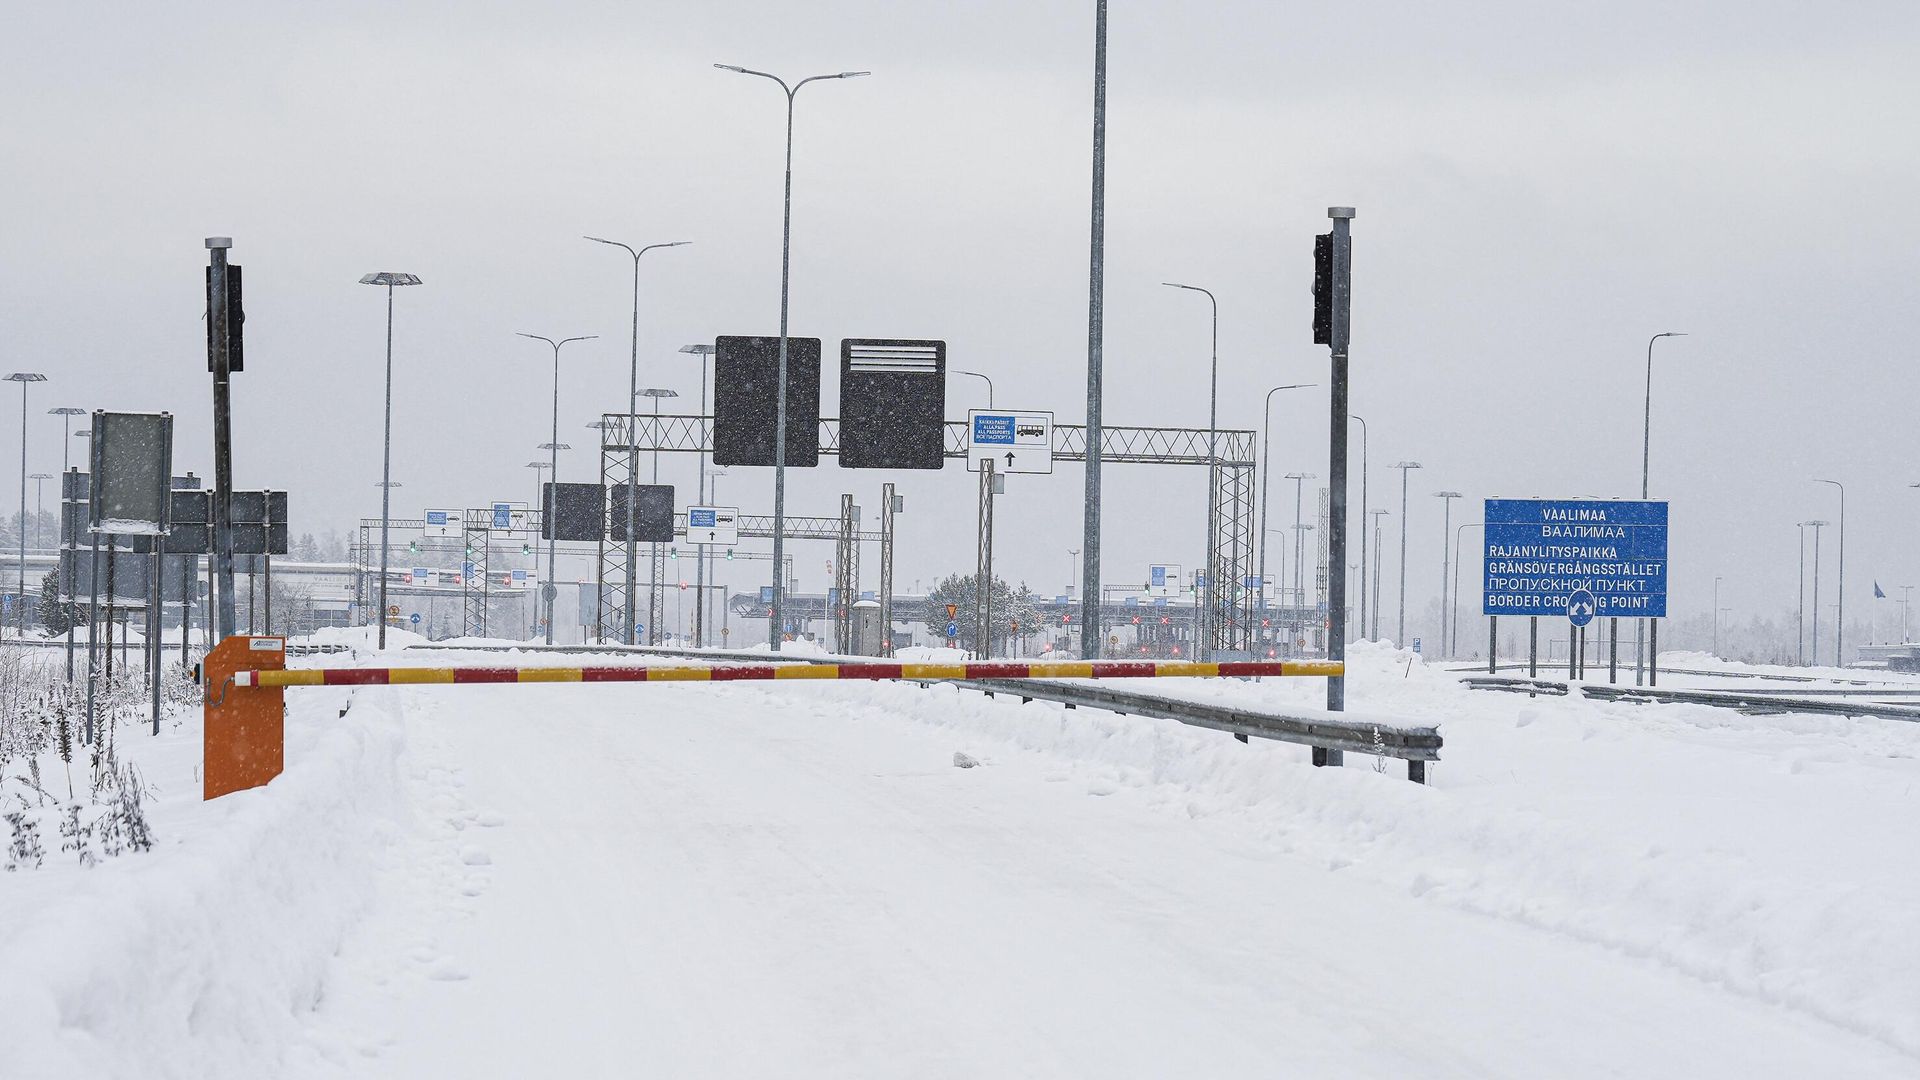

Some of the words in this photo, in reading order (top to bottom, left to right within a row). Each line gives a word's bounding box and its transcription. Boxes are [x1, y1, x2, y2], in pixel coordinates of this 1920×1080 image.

[1543, 509, 1606, 521] VAALIMAA
[1542, 526, 1625, 538] ВААЛИМАА
[1489, 545, 1617, 558] RAJANYLITYSPAIKKA
[1489, 560, 1661, 576] GRÄNSÖVERGÅNGSSTÄLLET
[1489, 576, 1592, 591] ПРОПУСКНОЙ
[1596, 579, 1645, 592] ПУНКТ
[1489, 595, 1540, 607] BORDER
[1544, 596, 1607, 608] CROG
[1611, 596, 1648, 608] POINT
